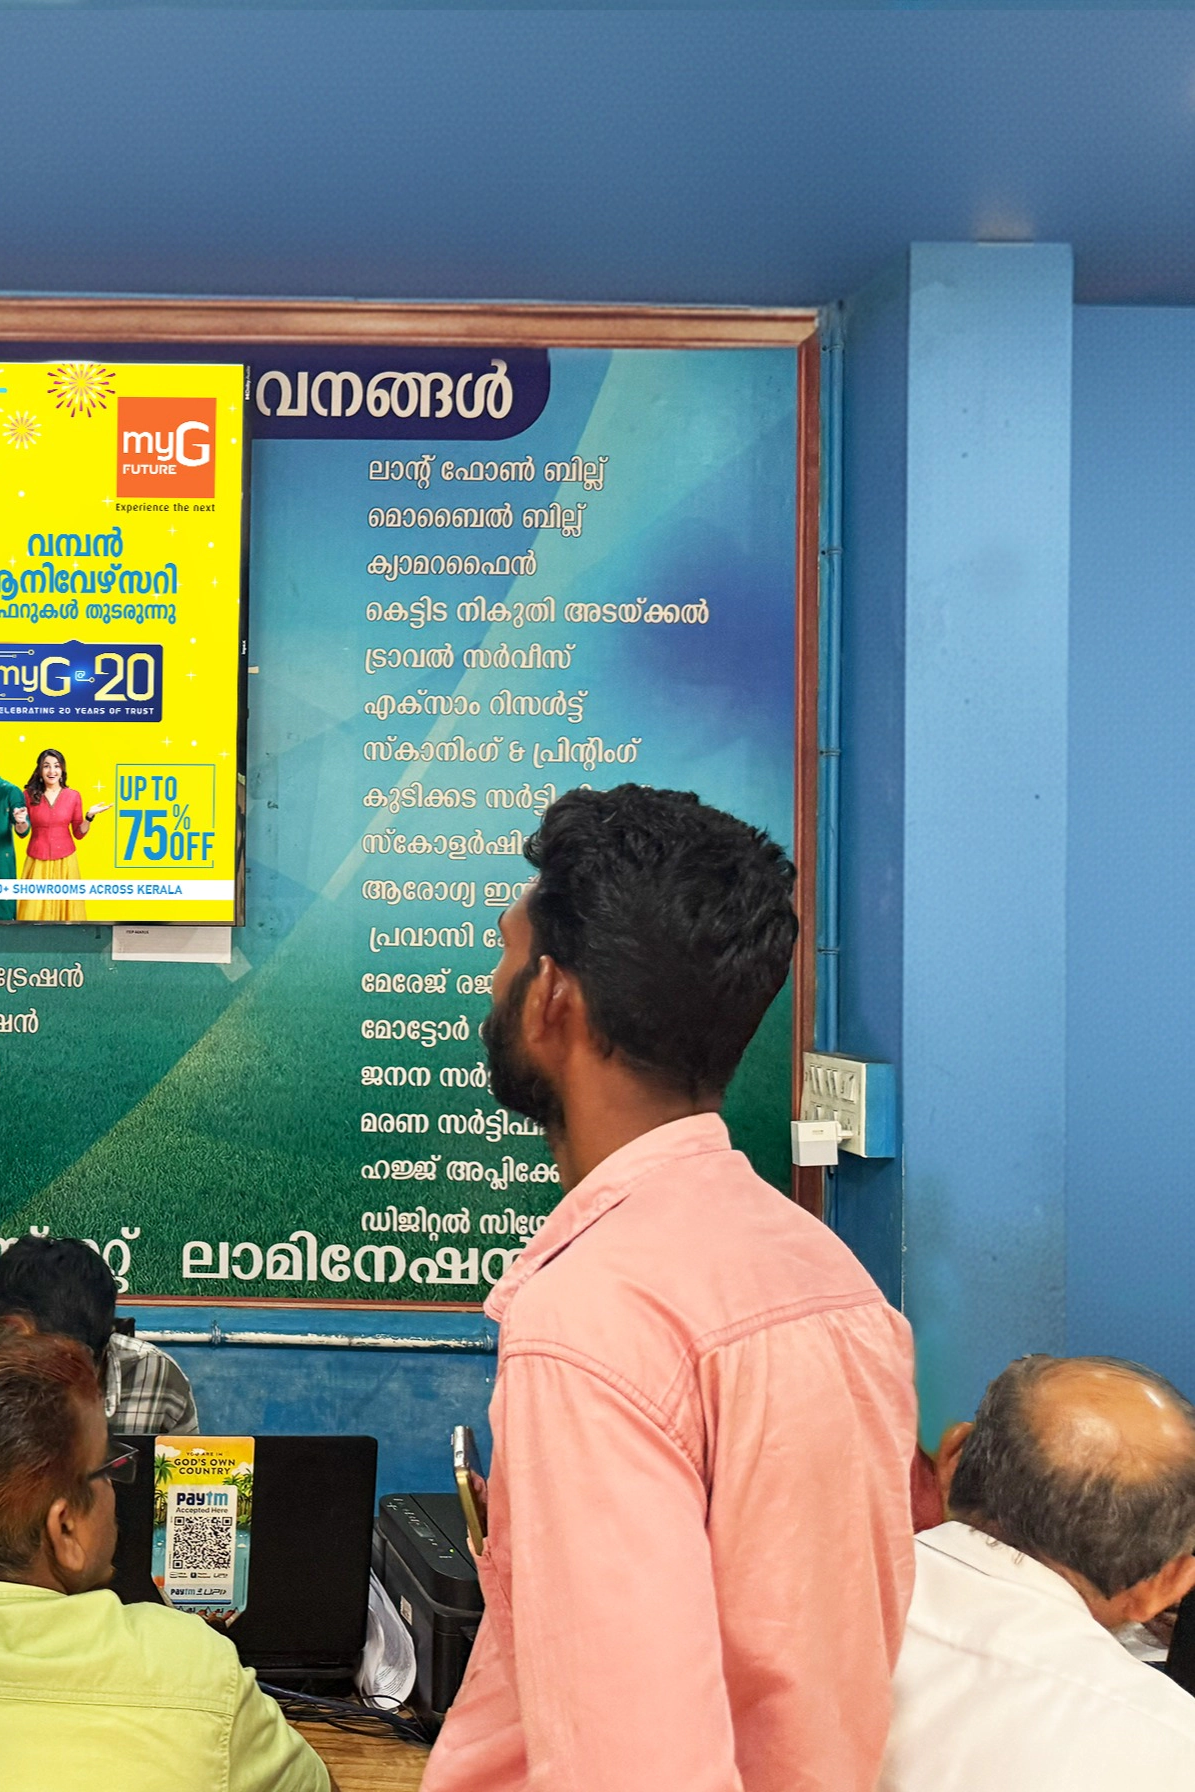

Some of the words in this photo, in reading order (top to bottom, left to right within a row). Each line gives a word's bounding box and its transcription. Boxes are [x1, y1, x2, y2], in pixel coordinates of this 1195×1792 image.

[123, 420, 210, 467] myG
[122, 464, 177, 475] FUTURE
[441, 456, 535, 482] ഫോൺ
[545, 455, 609, 492] ബില്ല്
[115, 503, 170, 513] Experience
[173, 503, 190, 512] the
[193, 504, 216, 512] next
[368, 503, 513, 529] മൊബൈൽ
[523, 503, 587, 538] ബില്ല്
[27, 526, 123, 557] വമ്പൻ
[85, 603, 177, 625] തുടരുന്നു
[366, 597, 448, 629] കെട്ടിട
[457, 596, 555, 628] നികുതി
[463, 643, 576, 669] സർവീസ്
[94, 652, 155, 702] 20
[58, 707, 71, 715] 20
[75, 707, 106, 715] YEARS
[109, 707, 122, 715] OF
[125, 707, 154, 715] TRUST
[509, 741, 526, 762] &
[120, 776, 146, 801] UP
[152, 776, 177, 802] TO
[170, 831, 215, 861] OFF
[362, 828, 526, 861] സ്കോളർഷി
[12, 884, 86, 894] SHOWROOMS
[89, 884, 134, 895] ACROSS
[137, 884, 183, 895] KERALA
[361, 968, 452, 994] മേരേജ്
[361, 1015, 470, 1048] മോട്ടോർ
[361, 1065, 431, 1087] ജനന
[361, 1112, 429, 1133] മരണ
[361, 1205, 470, 1241] ഡിജിറ്റൽ
[179, 1467, 230, 1475] COUNTRY
